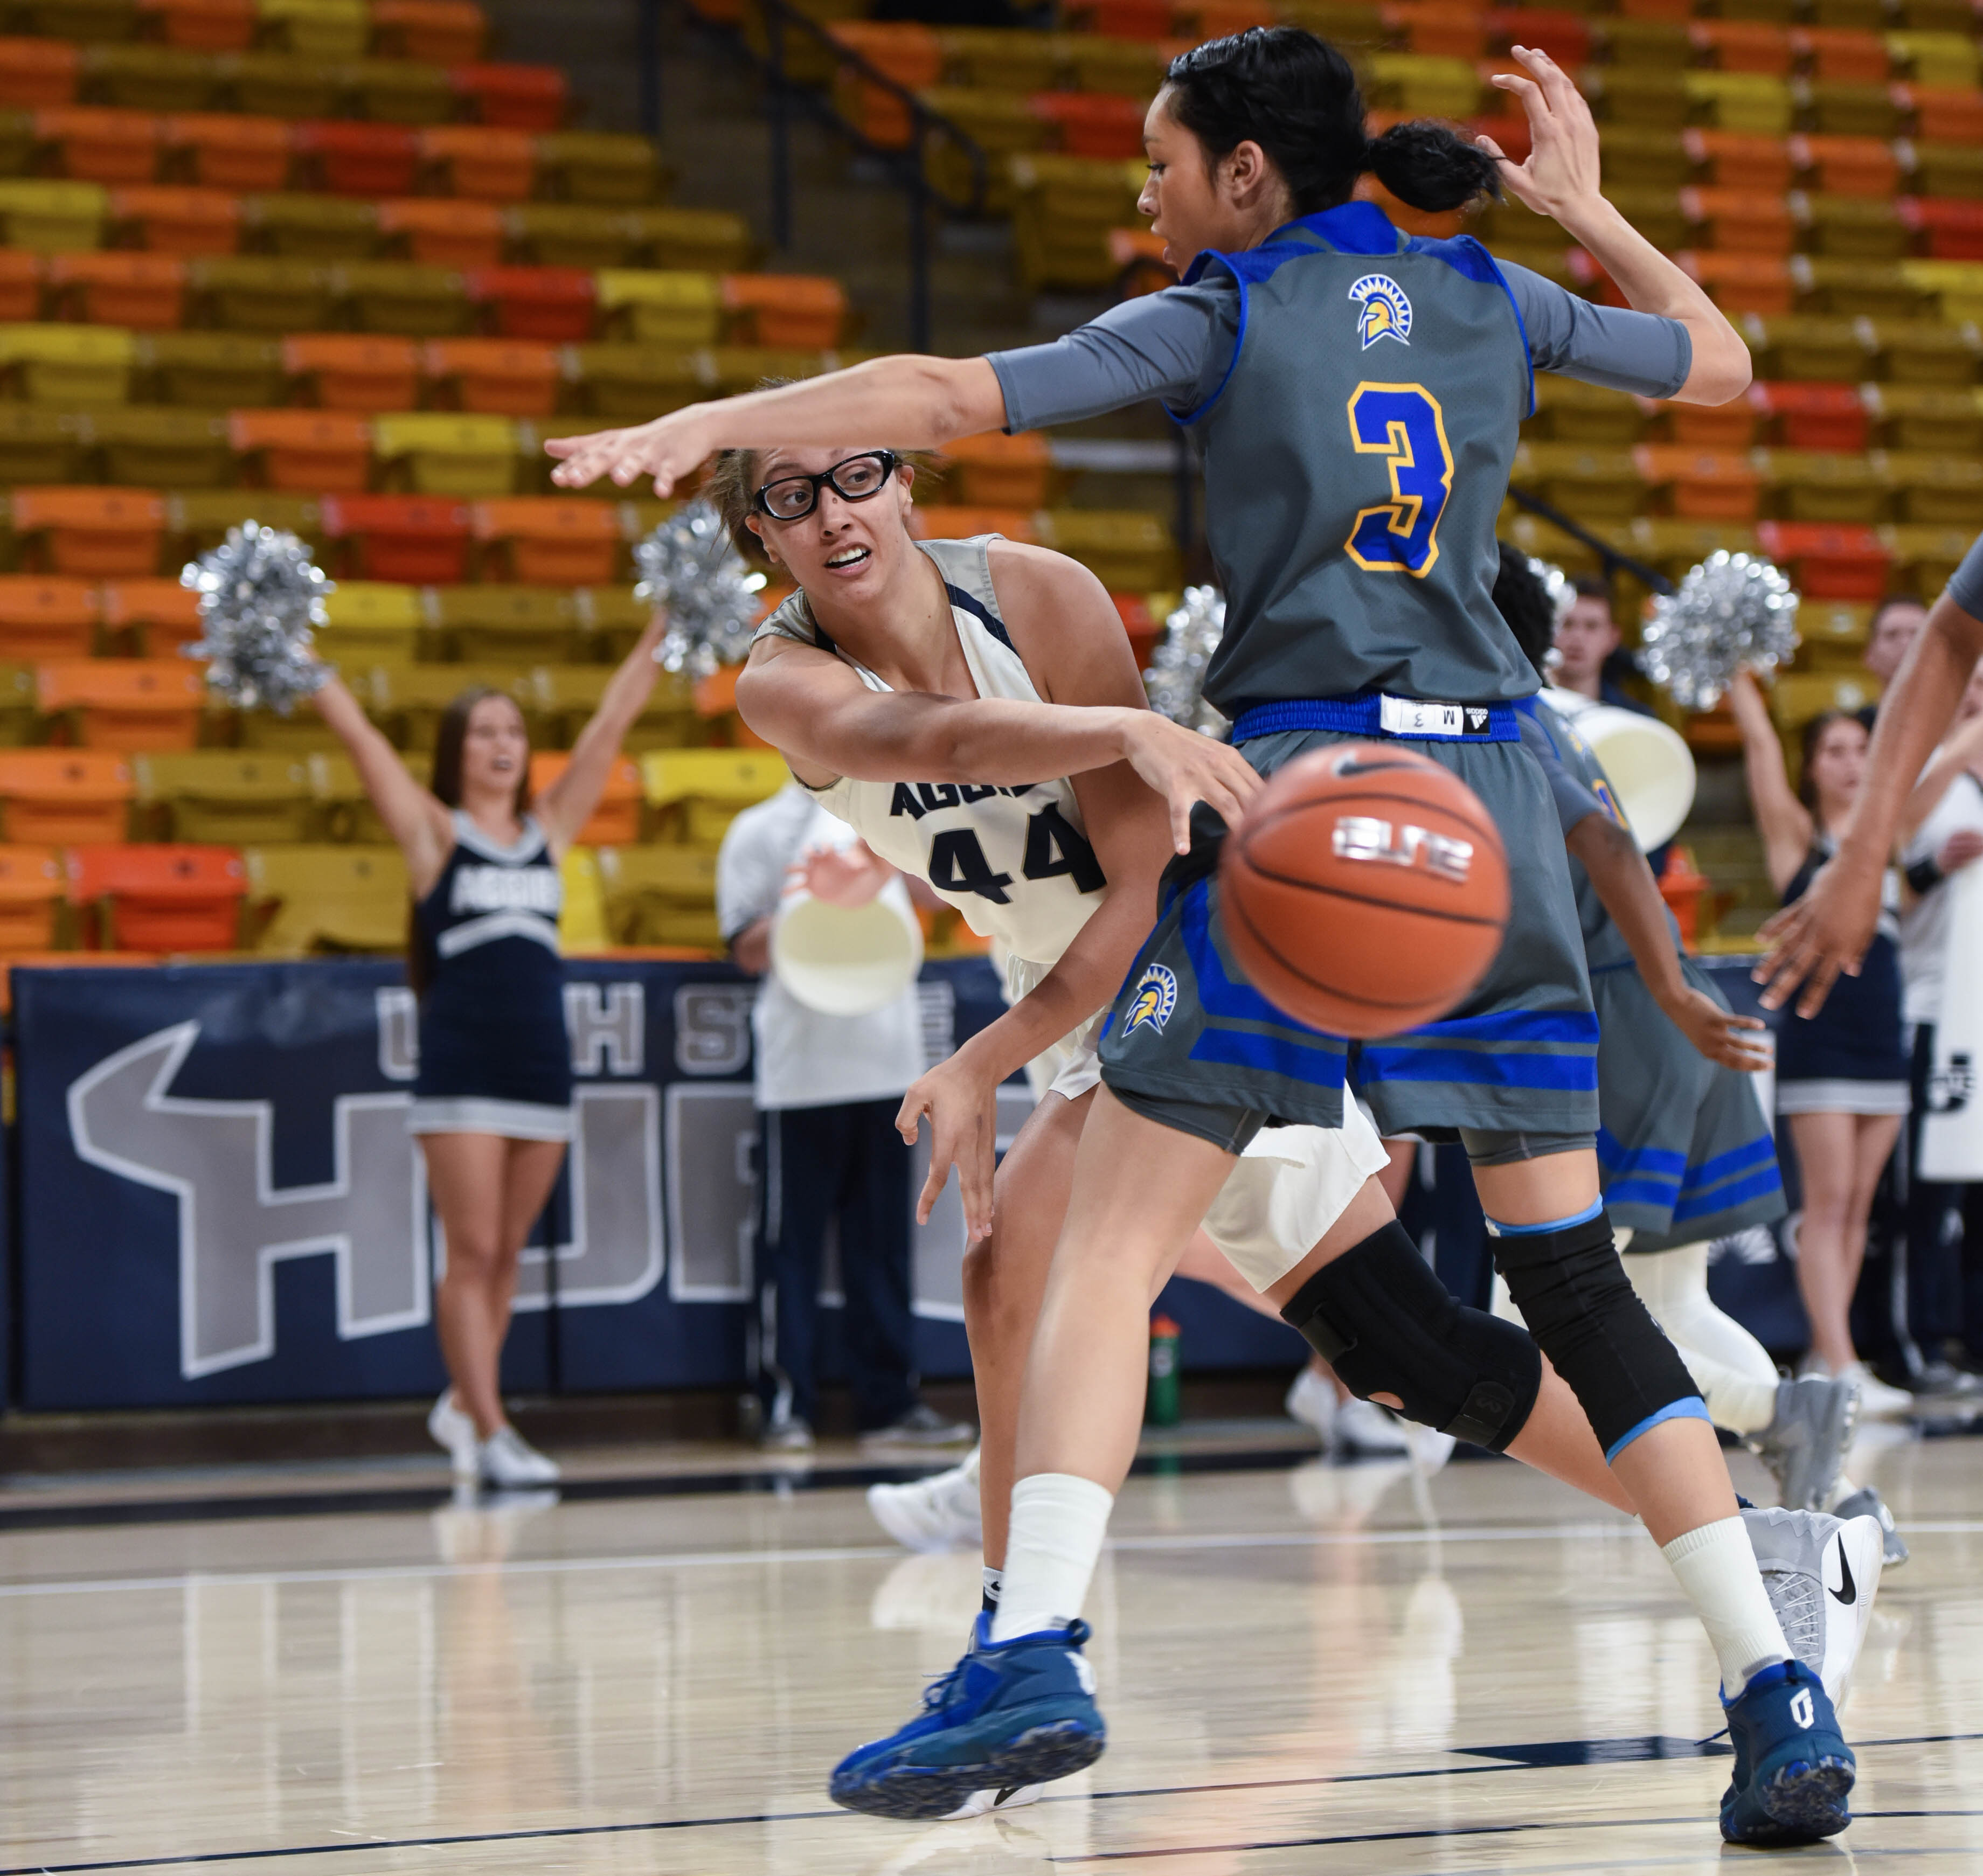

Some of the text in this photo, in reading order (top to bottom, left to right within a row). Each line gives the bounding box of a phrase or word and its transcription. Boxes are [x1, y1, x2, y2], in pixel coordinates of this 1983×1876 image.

[1344, 380, 1455, 579] 3
[1466, 707, 1488, 715] adidas
[927, 799, 1108, 905] 44
